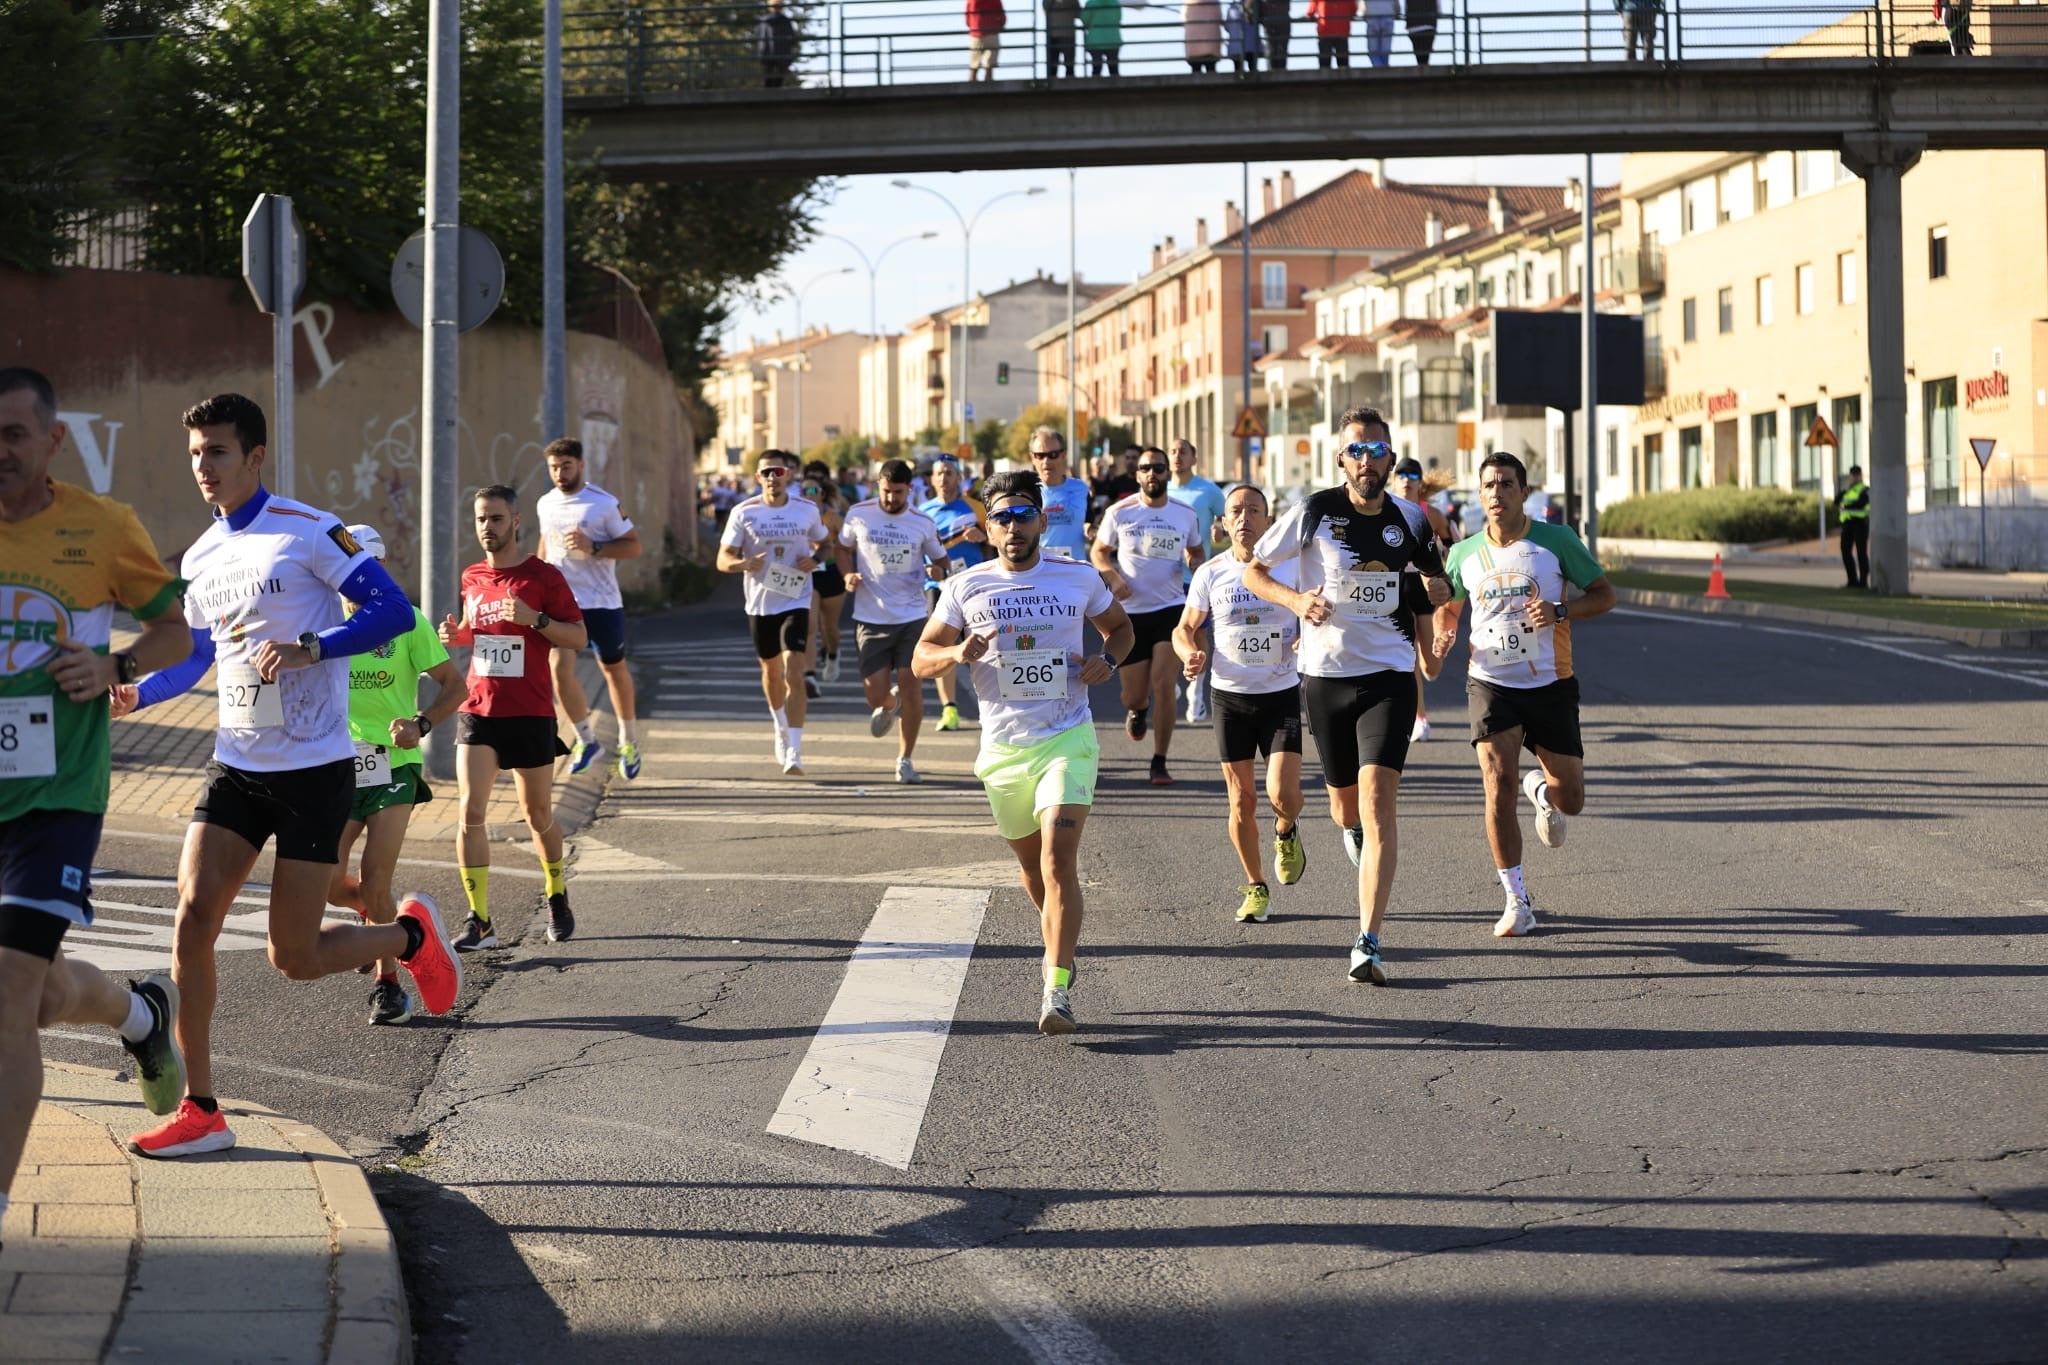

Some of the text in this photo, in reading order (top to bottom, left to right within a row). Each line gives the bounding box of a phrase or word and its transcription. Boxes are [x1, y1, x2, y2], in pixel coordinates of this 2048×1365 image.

[1151, 537, 1175, 551] 248
[880, 552, 904, 565] 242
[243, 578, 286, 598] CIVIL
[1350, 586, 1386, 603] 496
[1483, 586, 1532, 600] ALCER
[988, 595, 1060, 607] III CARRERA
[972, 607, 1036, 624] GVARDIA
[1238, 637, 1271, 653] 434
[1498, 634, 1519, 651] 19
[481, 648, 512, 664] 110
[1012, 664, 1053, 685] 266
[226, 684, 261, 707] 527
